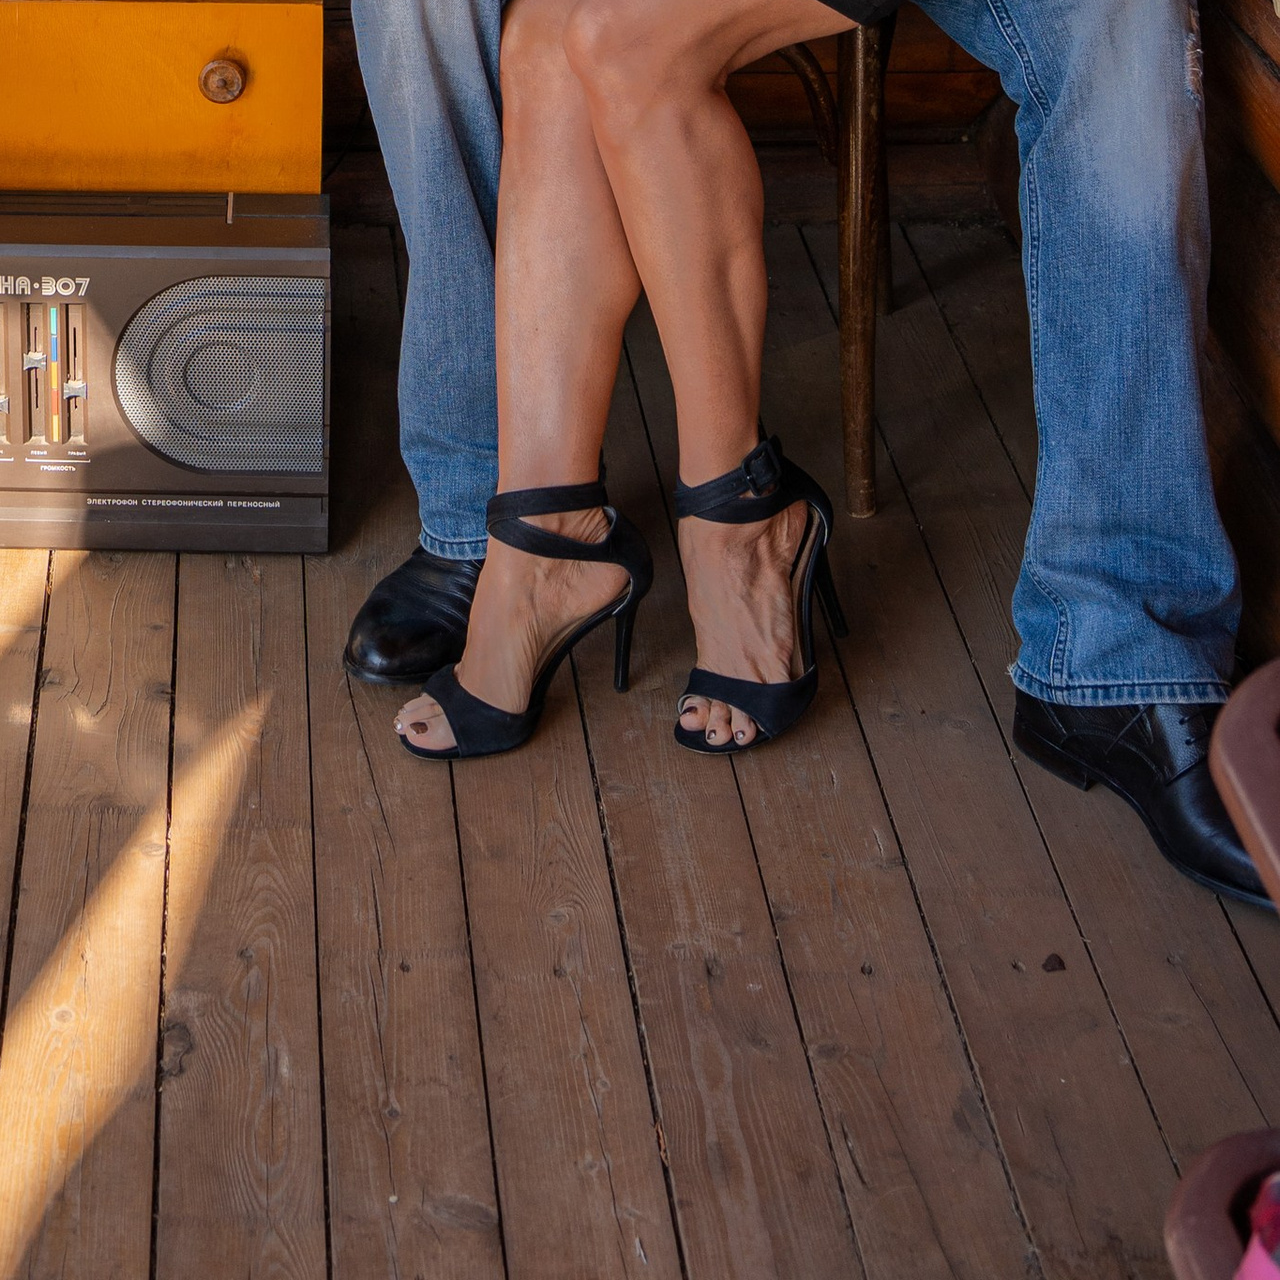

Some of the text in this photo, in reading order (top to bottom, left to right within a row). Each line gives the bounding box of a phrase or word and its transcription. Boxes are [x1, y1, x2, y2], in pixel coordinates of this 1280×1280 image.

[86, 497, 280, 508] ЭЛЕКТРОФОН СТЕРЕОФОНИЧЕСКИЙ ПЕРЕНОСНЫЙ
